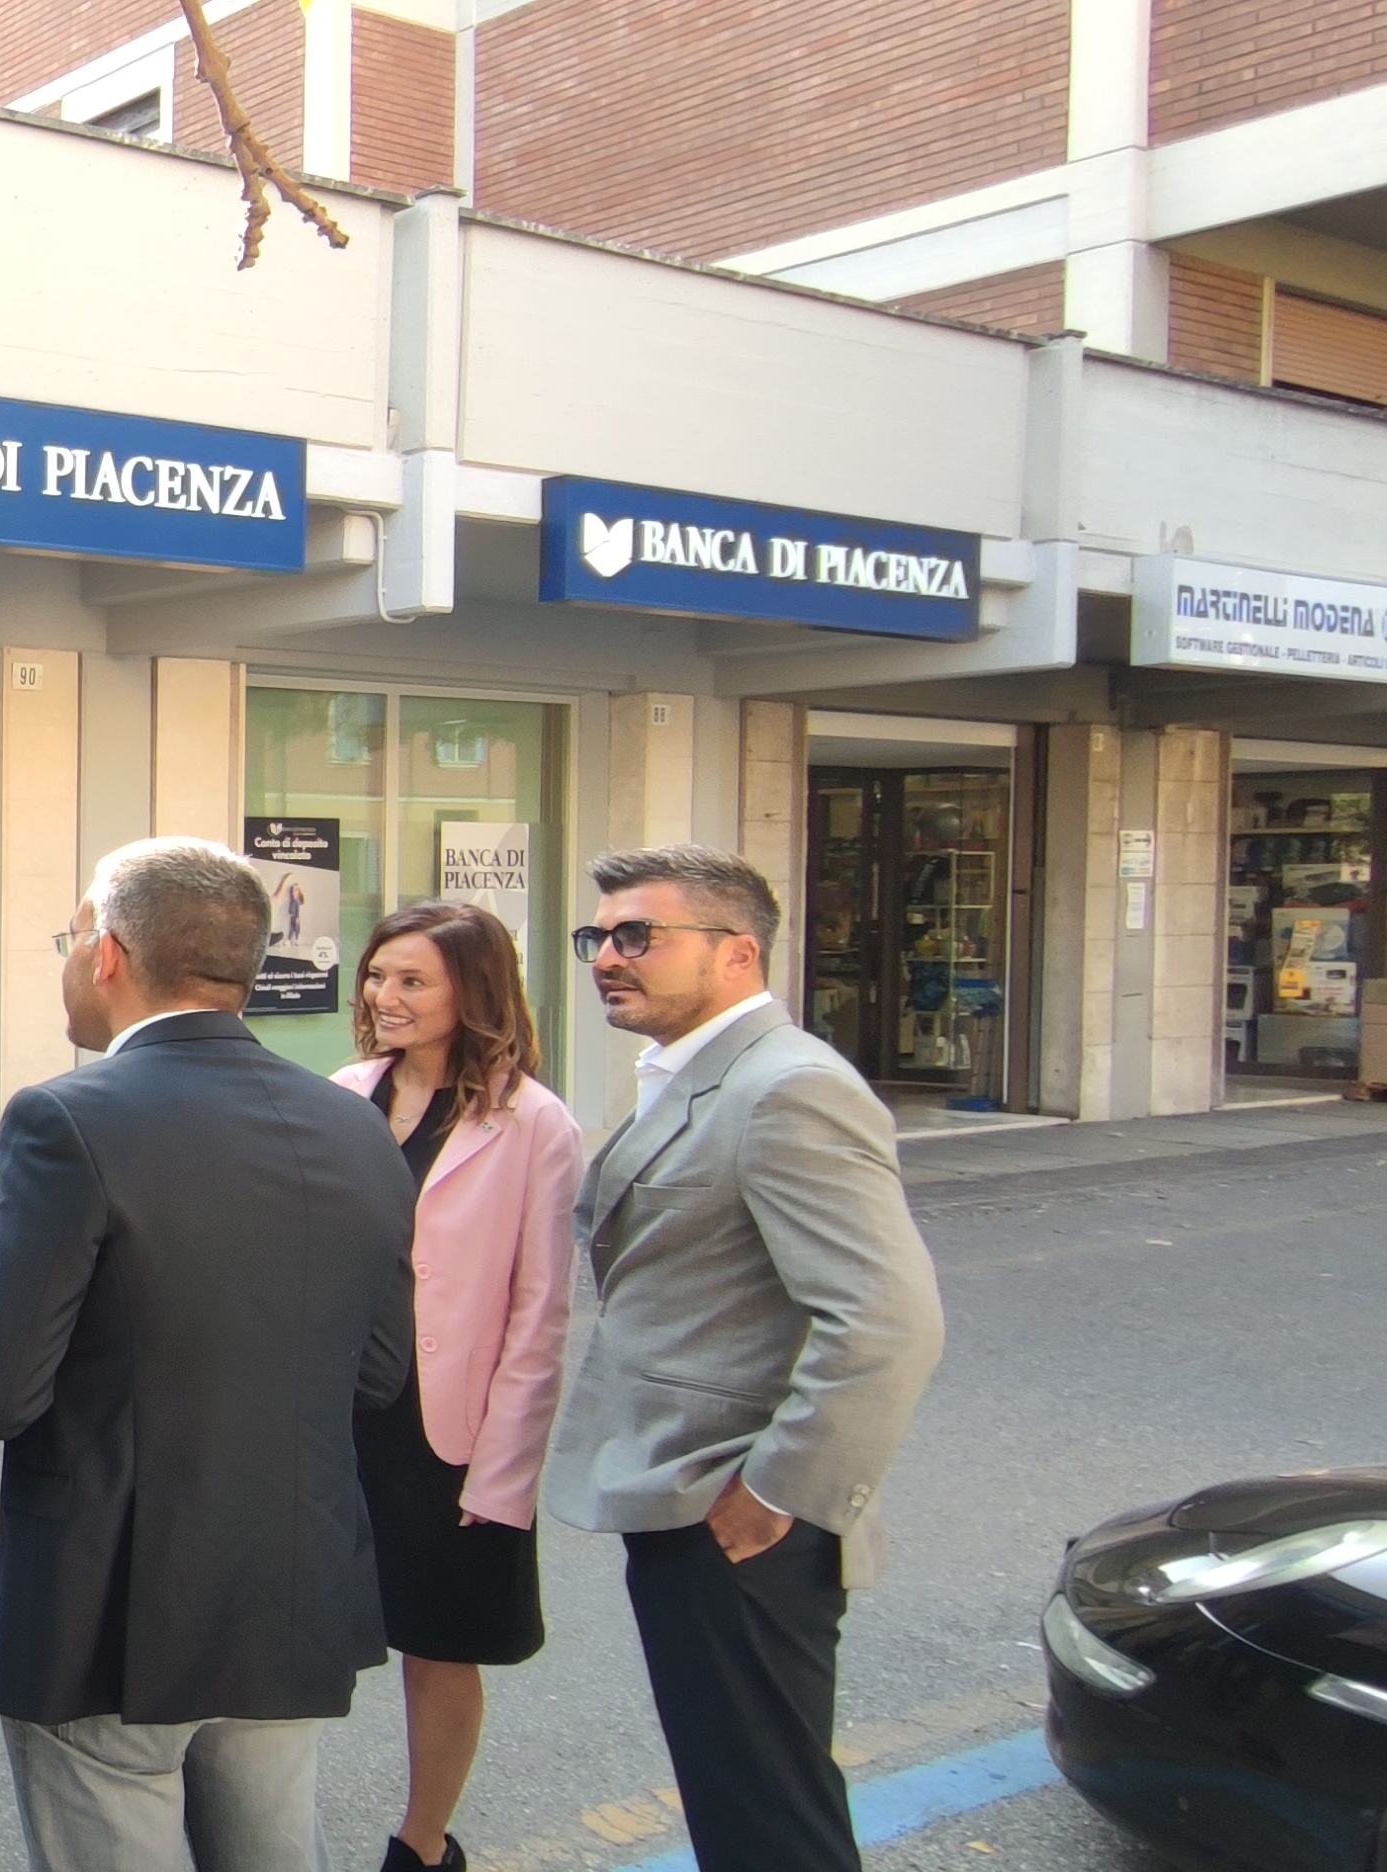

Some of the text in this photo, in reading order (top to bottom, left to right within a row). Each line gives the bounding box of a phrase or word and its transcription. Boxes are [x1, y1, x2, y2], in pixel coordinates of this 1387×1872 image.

[41, 445, 287, 521] PIACENZA
[639, 519, 970, 600] BANCA DI PIACENZA
[1293, 599, 1375, 637] MODENA
[1176, 636, 1224, 654] SOFTWARE
[1227, 641, 1280, 659] GESTIONALE
[20, 667, 36, 686] 90
[445, 848, 525, 867] BANCA DI
[444, 871, 526, 890] PIACENZA
